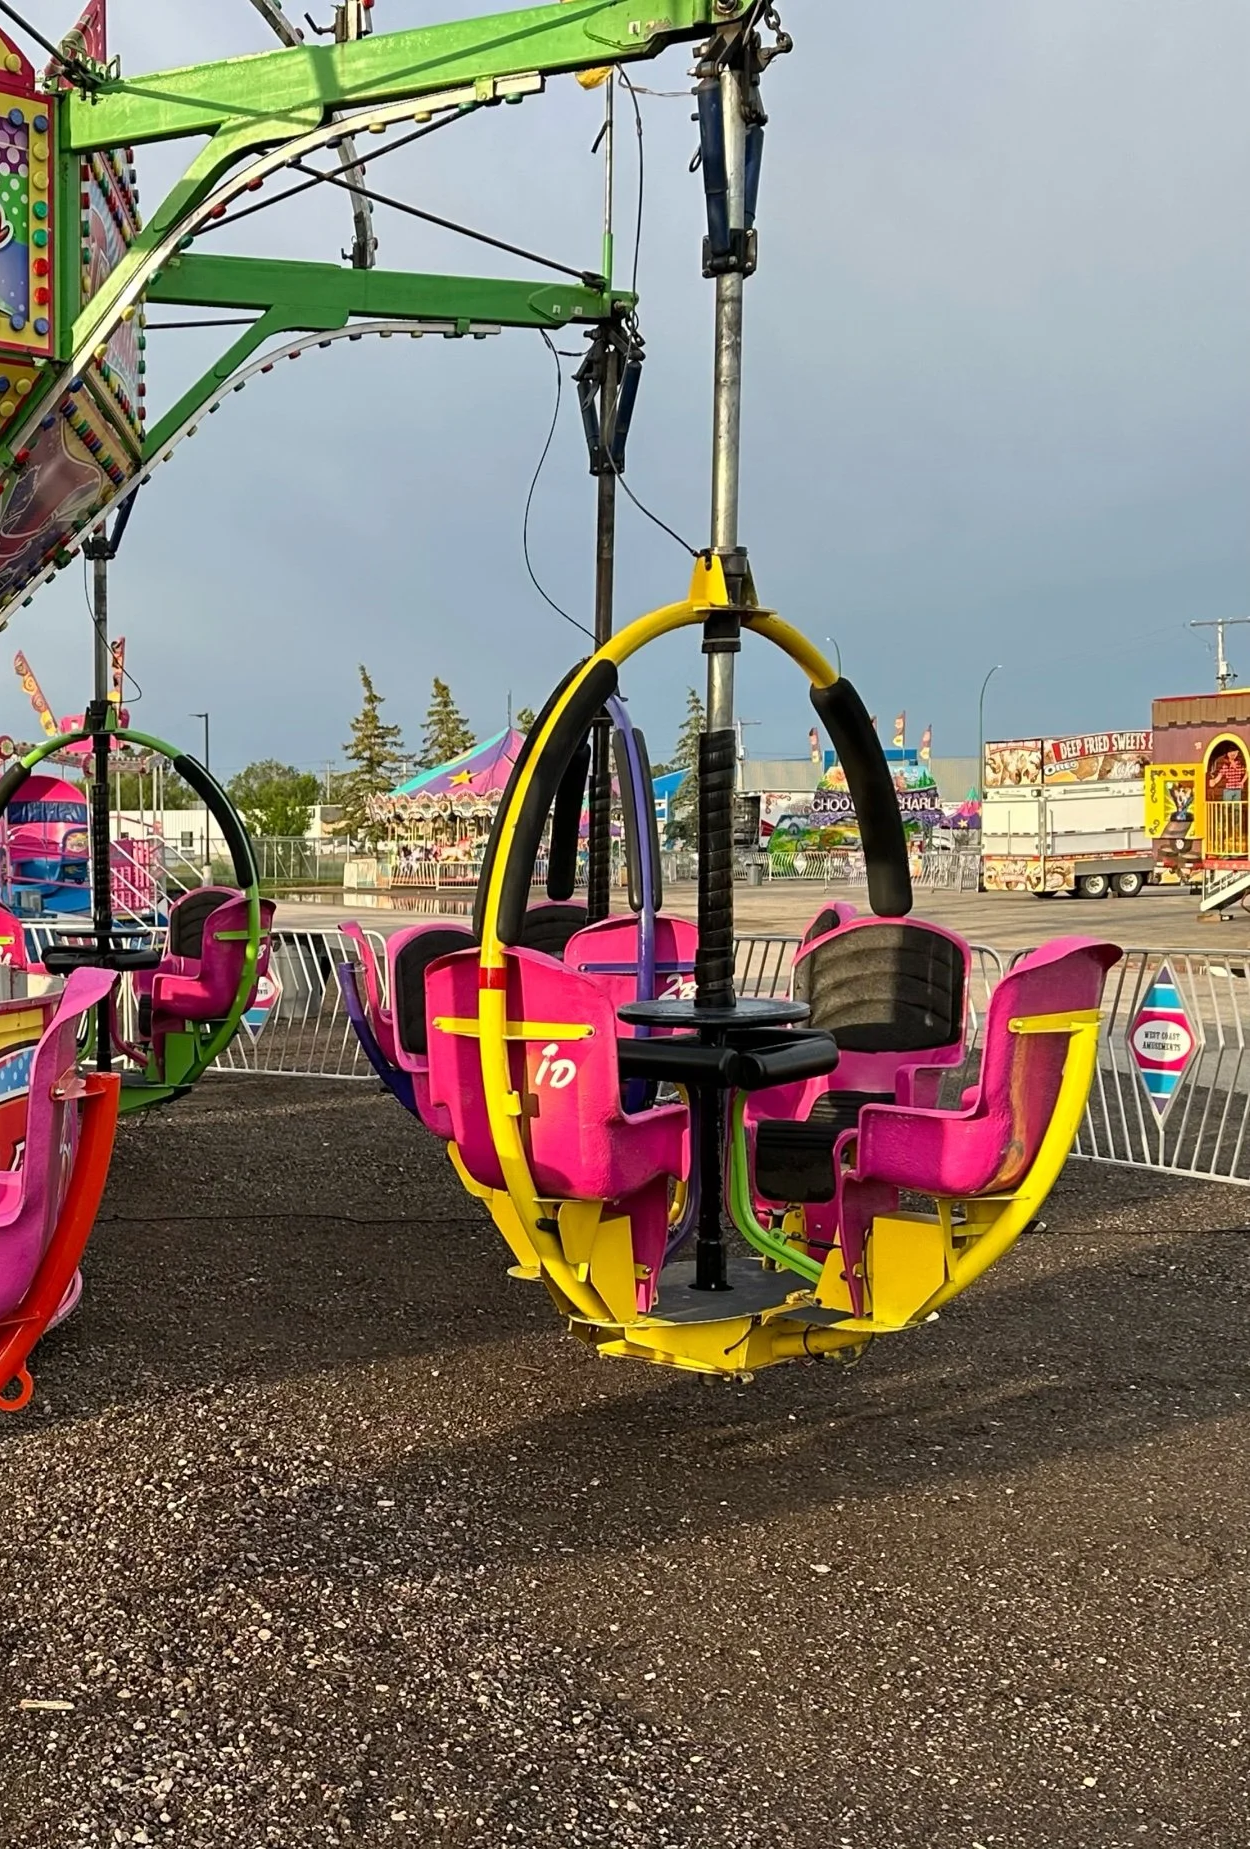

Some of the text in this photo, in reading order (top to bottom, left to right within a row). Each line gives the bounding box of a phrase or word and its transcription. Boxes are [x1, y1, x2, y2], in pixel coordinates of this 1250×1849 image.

[1059, 739, 1082, 759] DEEP
[1084, 735, 1110, 755] FRIED
[1111, 733, 1146, 751] SWEETS
[811, 798, 850, 811] CHOO
[1144, 1031, 1160, 1040] WEST
